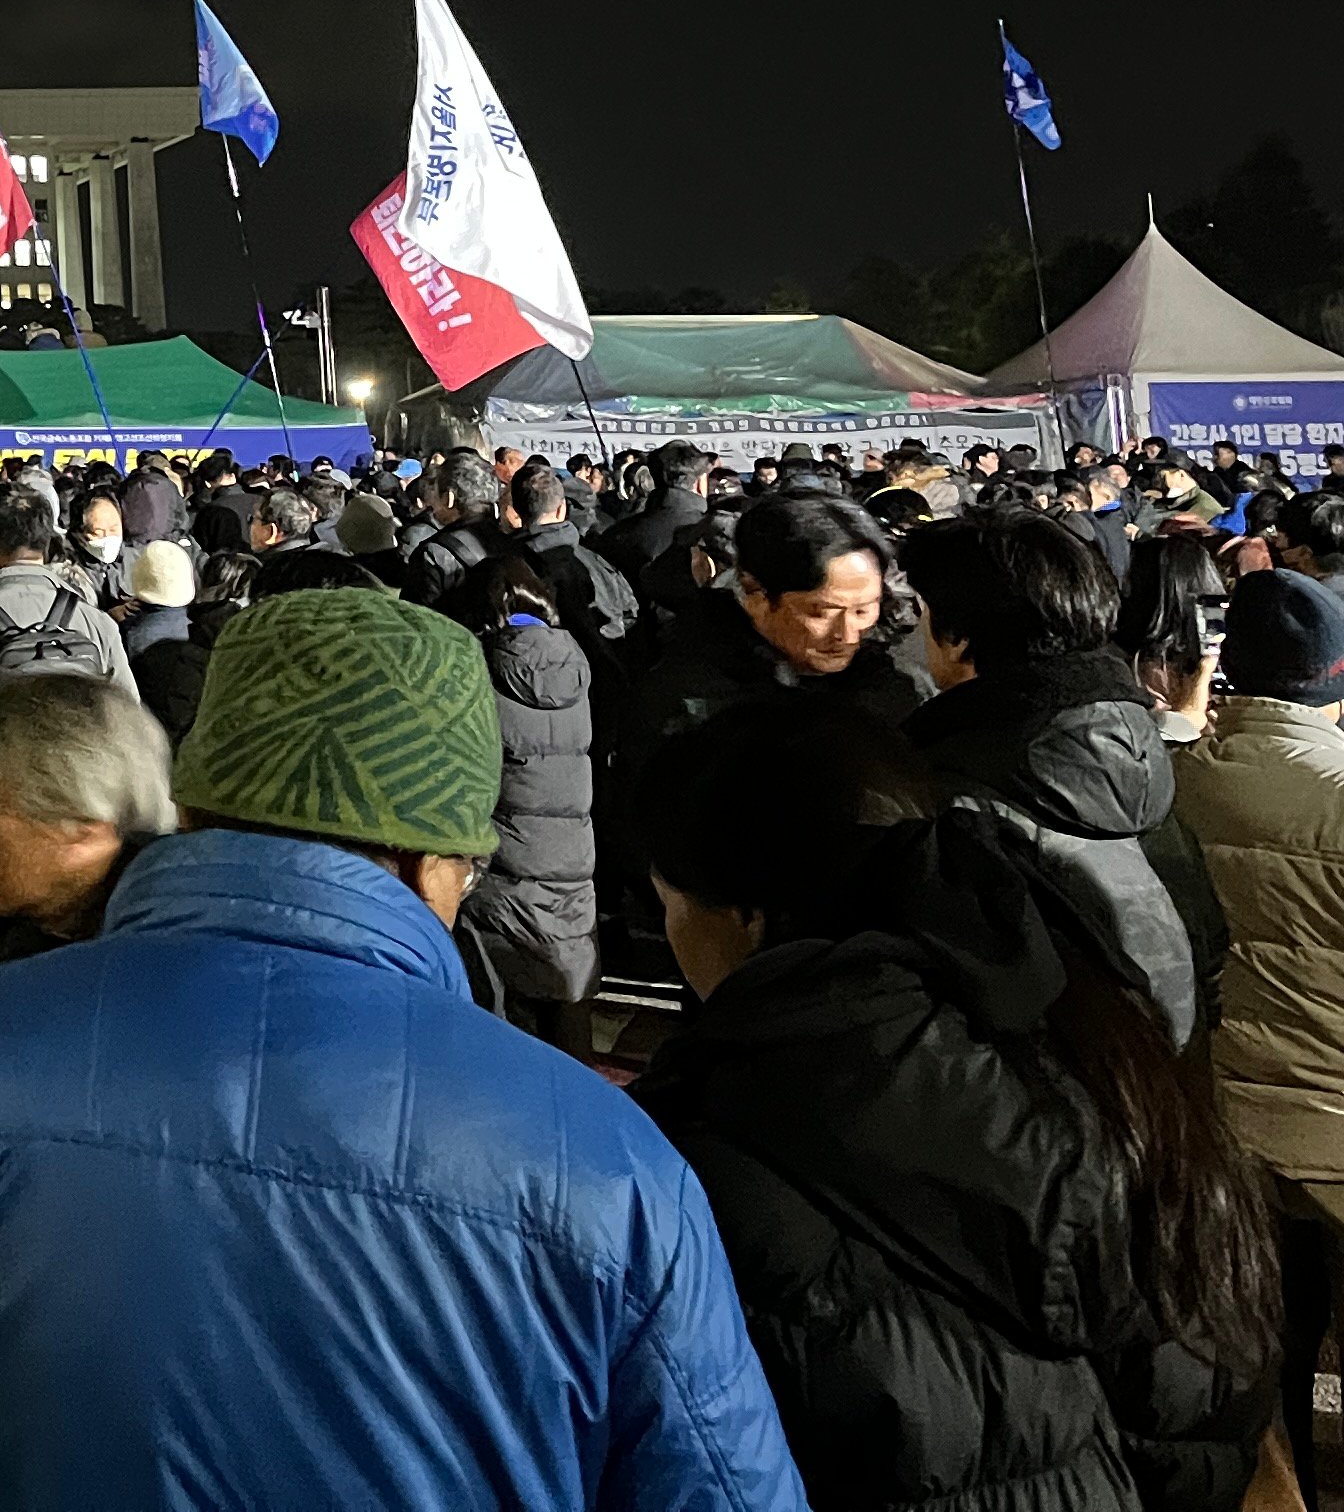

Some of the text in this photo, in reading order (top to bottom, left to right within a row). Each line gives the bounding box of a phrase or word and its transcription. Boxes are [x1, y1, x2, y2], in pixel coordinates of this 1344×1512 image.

[1169, 423, 1344, 447] 간호사 1인 담당 환자
[520, 439, 572, 456] 사회적
